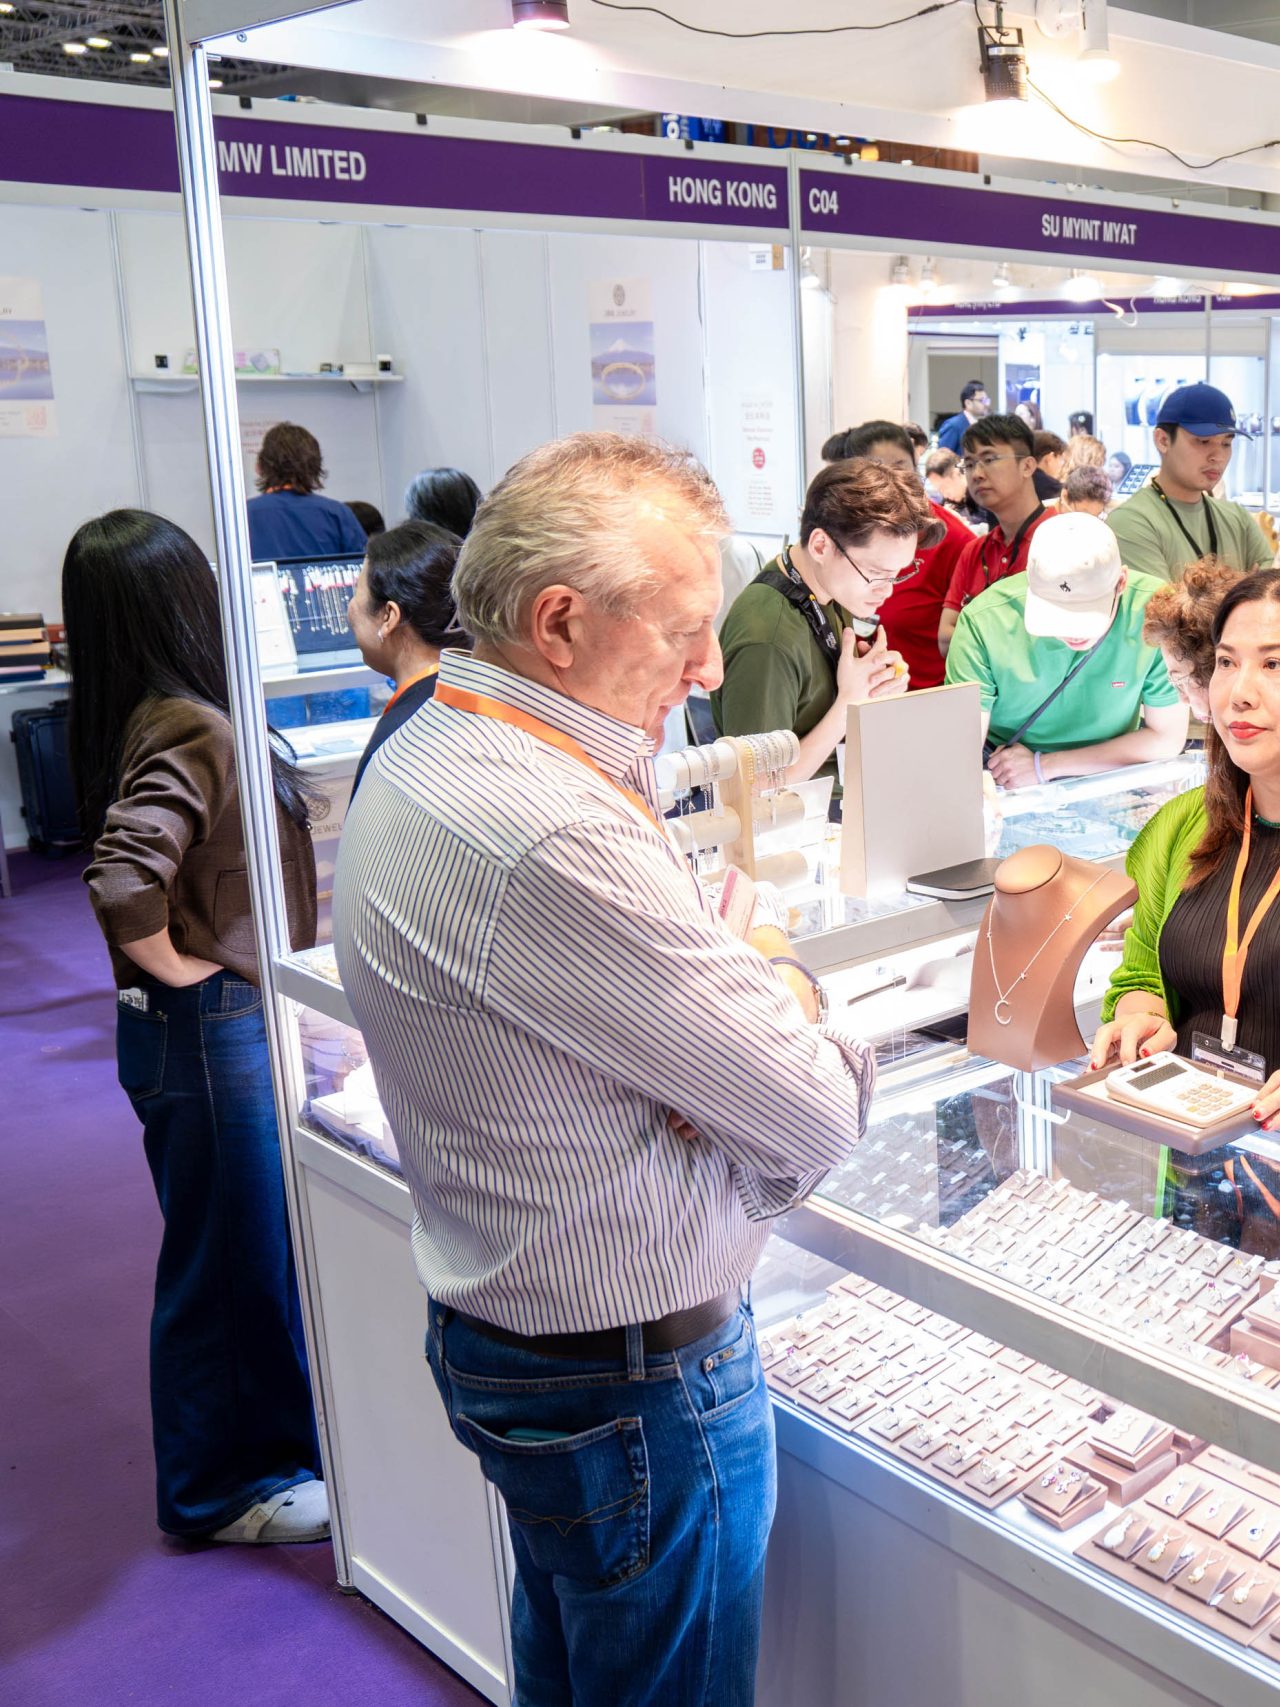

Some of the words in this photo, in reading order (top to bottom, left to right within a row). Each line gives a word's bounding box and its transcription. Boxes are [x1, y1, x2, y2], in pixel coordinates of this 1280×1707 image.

[217, 140, 263, 175] MW
[270, 144, 367, 181] LIMITED
[668, 176, 722, 205] HONG
[726, 180, 777, 209] KONG
[808, 187, 839, 214] C04
[1041, 213, 1060, 237] SU
[1062, 216, 1101, 241] MYINT
[1103, 221, 1137, 245] MYAT
